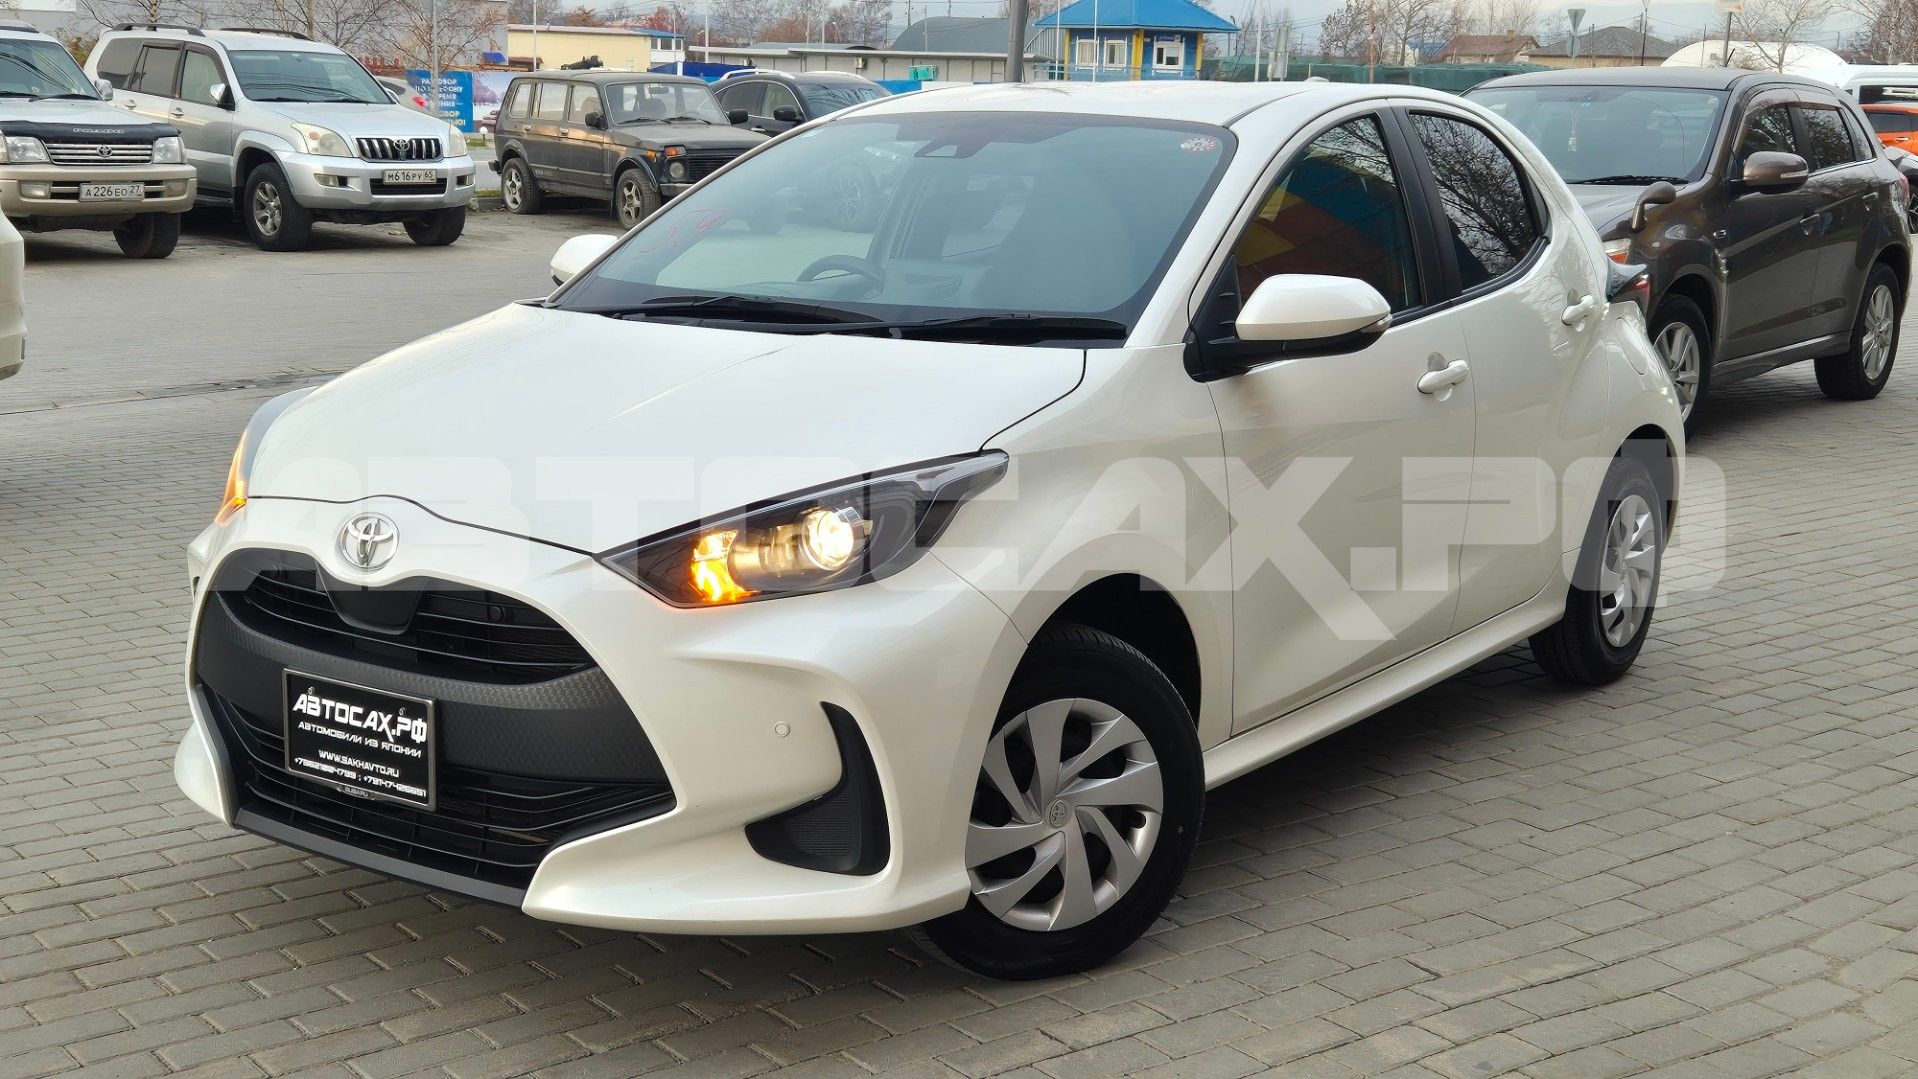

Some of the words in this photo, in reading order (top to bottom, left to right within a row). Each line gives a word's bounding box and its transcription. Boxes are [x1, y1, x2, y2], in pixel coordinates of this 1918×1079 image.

[292, 693, 427, 744] АВТОСАХ.РФ
[297, 721, 362, 744] АВТОМОБИЛИ
[364, 737, 379, 748] ИЗ
[381, 742, 422, 758] ЯПОНИИ
[318, 749, 400, 778] WWW.SAKHAVTO.RU
